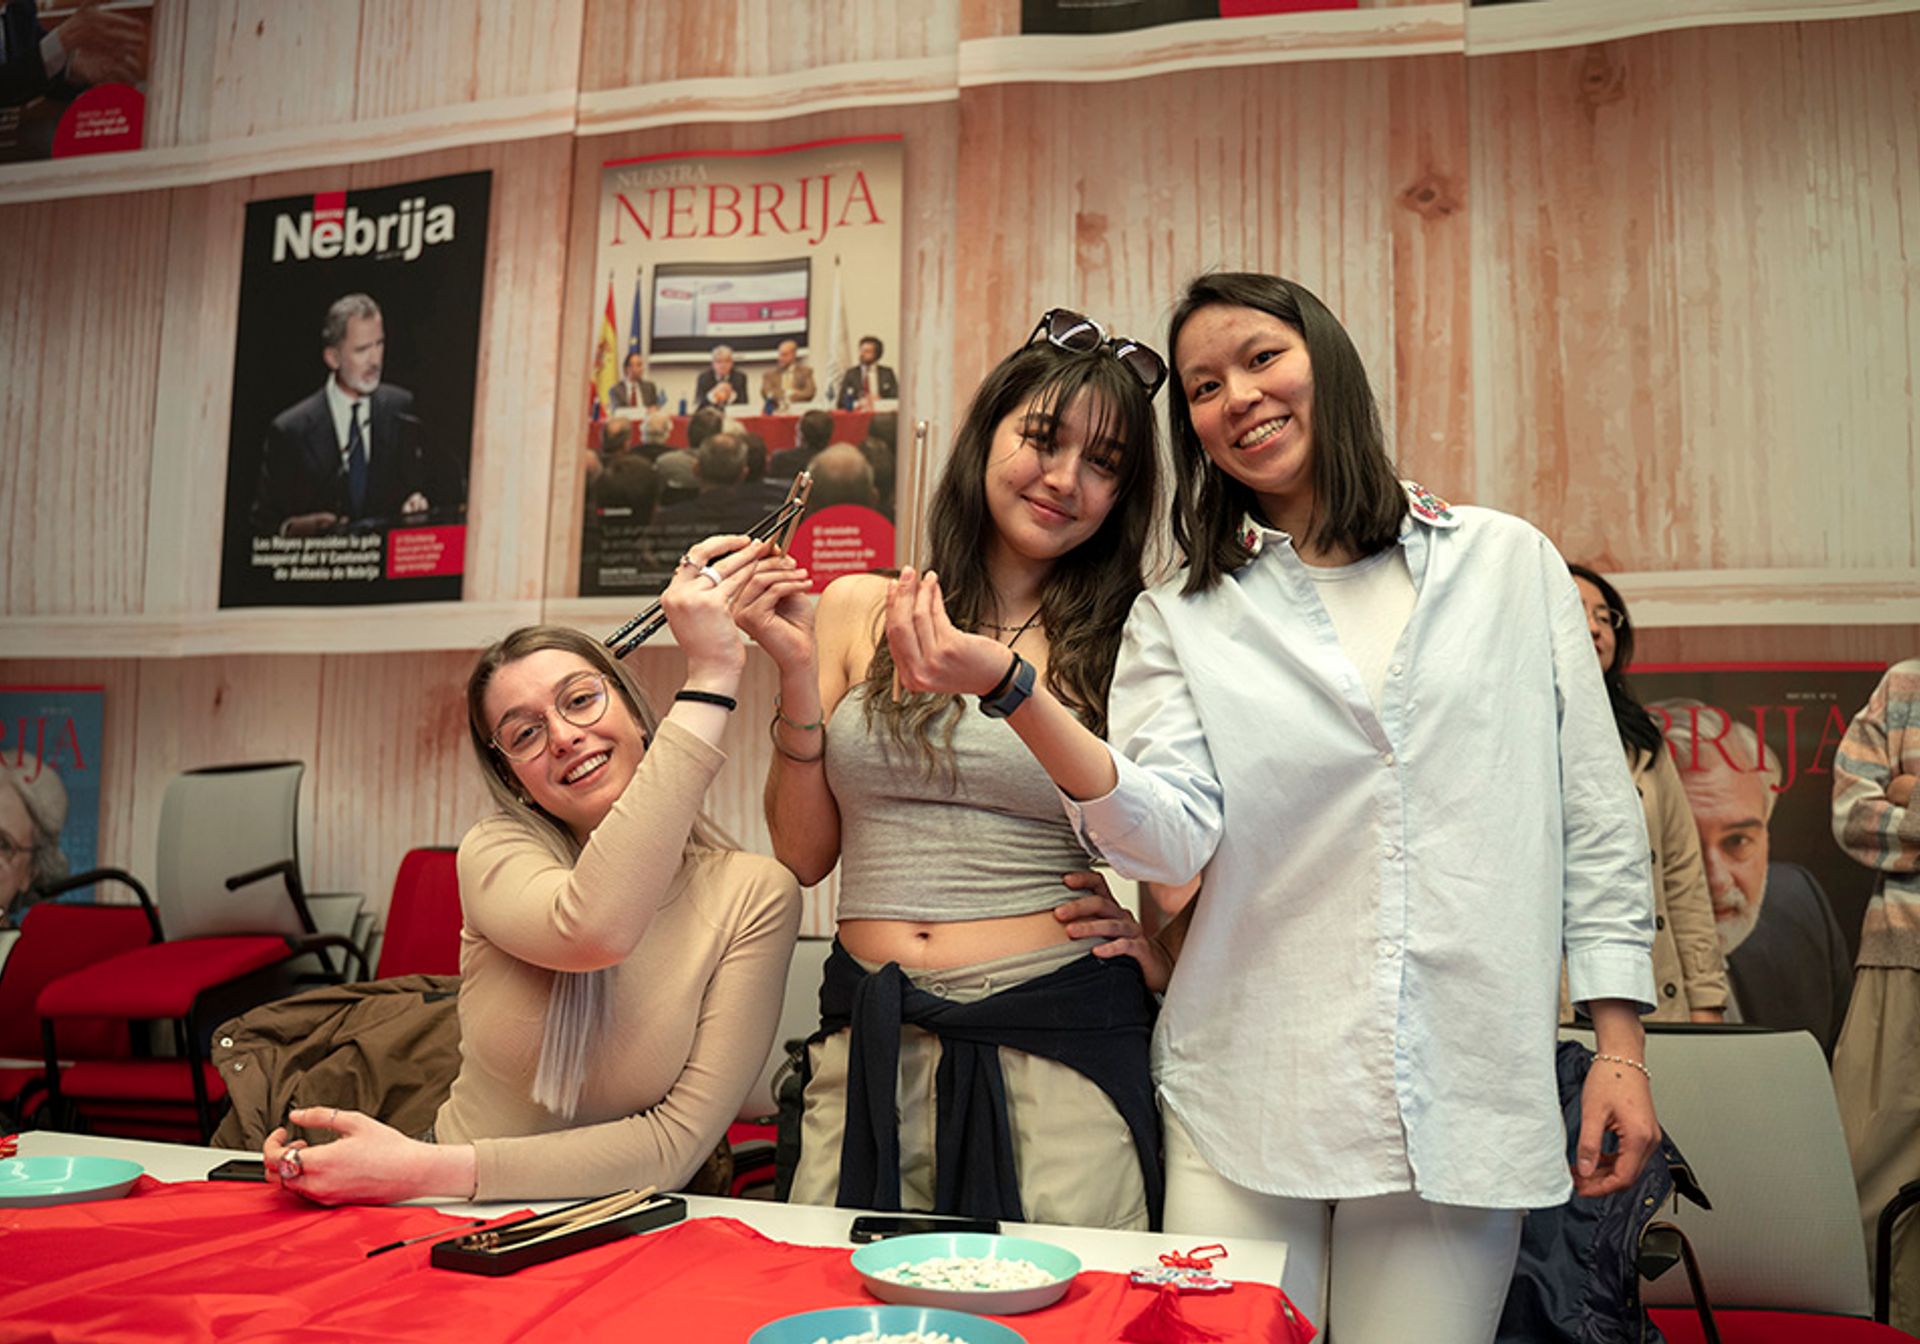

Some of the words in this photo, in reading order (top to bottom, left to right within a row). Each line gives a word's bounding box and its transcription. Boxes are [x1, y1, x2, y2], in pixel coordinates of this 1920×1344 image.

[609, 169, 887, 247] NEBRIJA
[615, 163, 709, 190] NUESTRA
[272, 196, 456, 263] Nebrija
